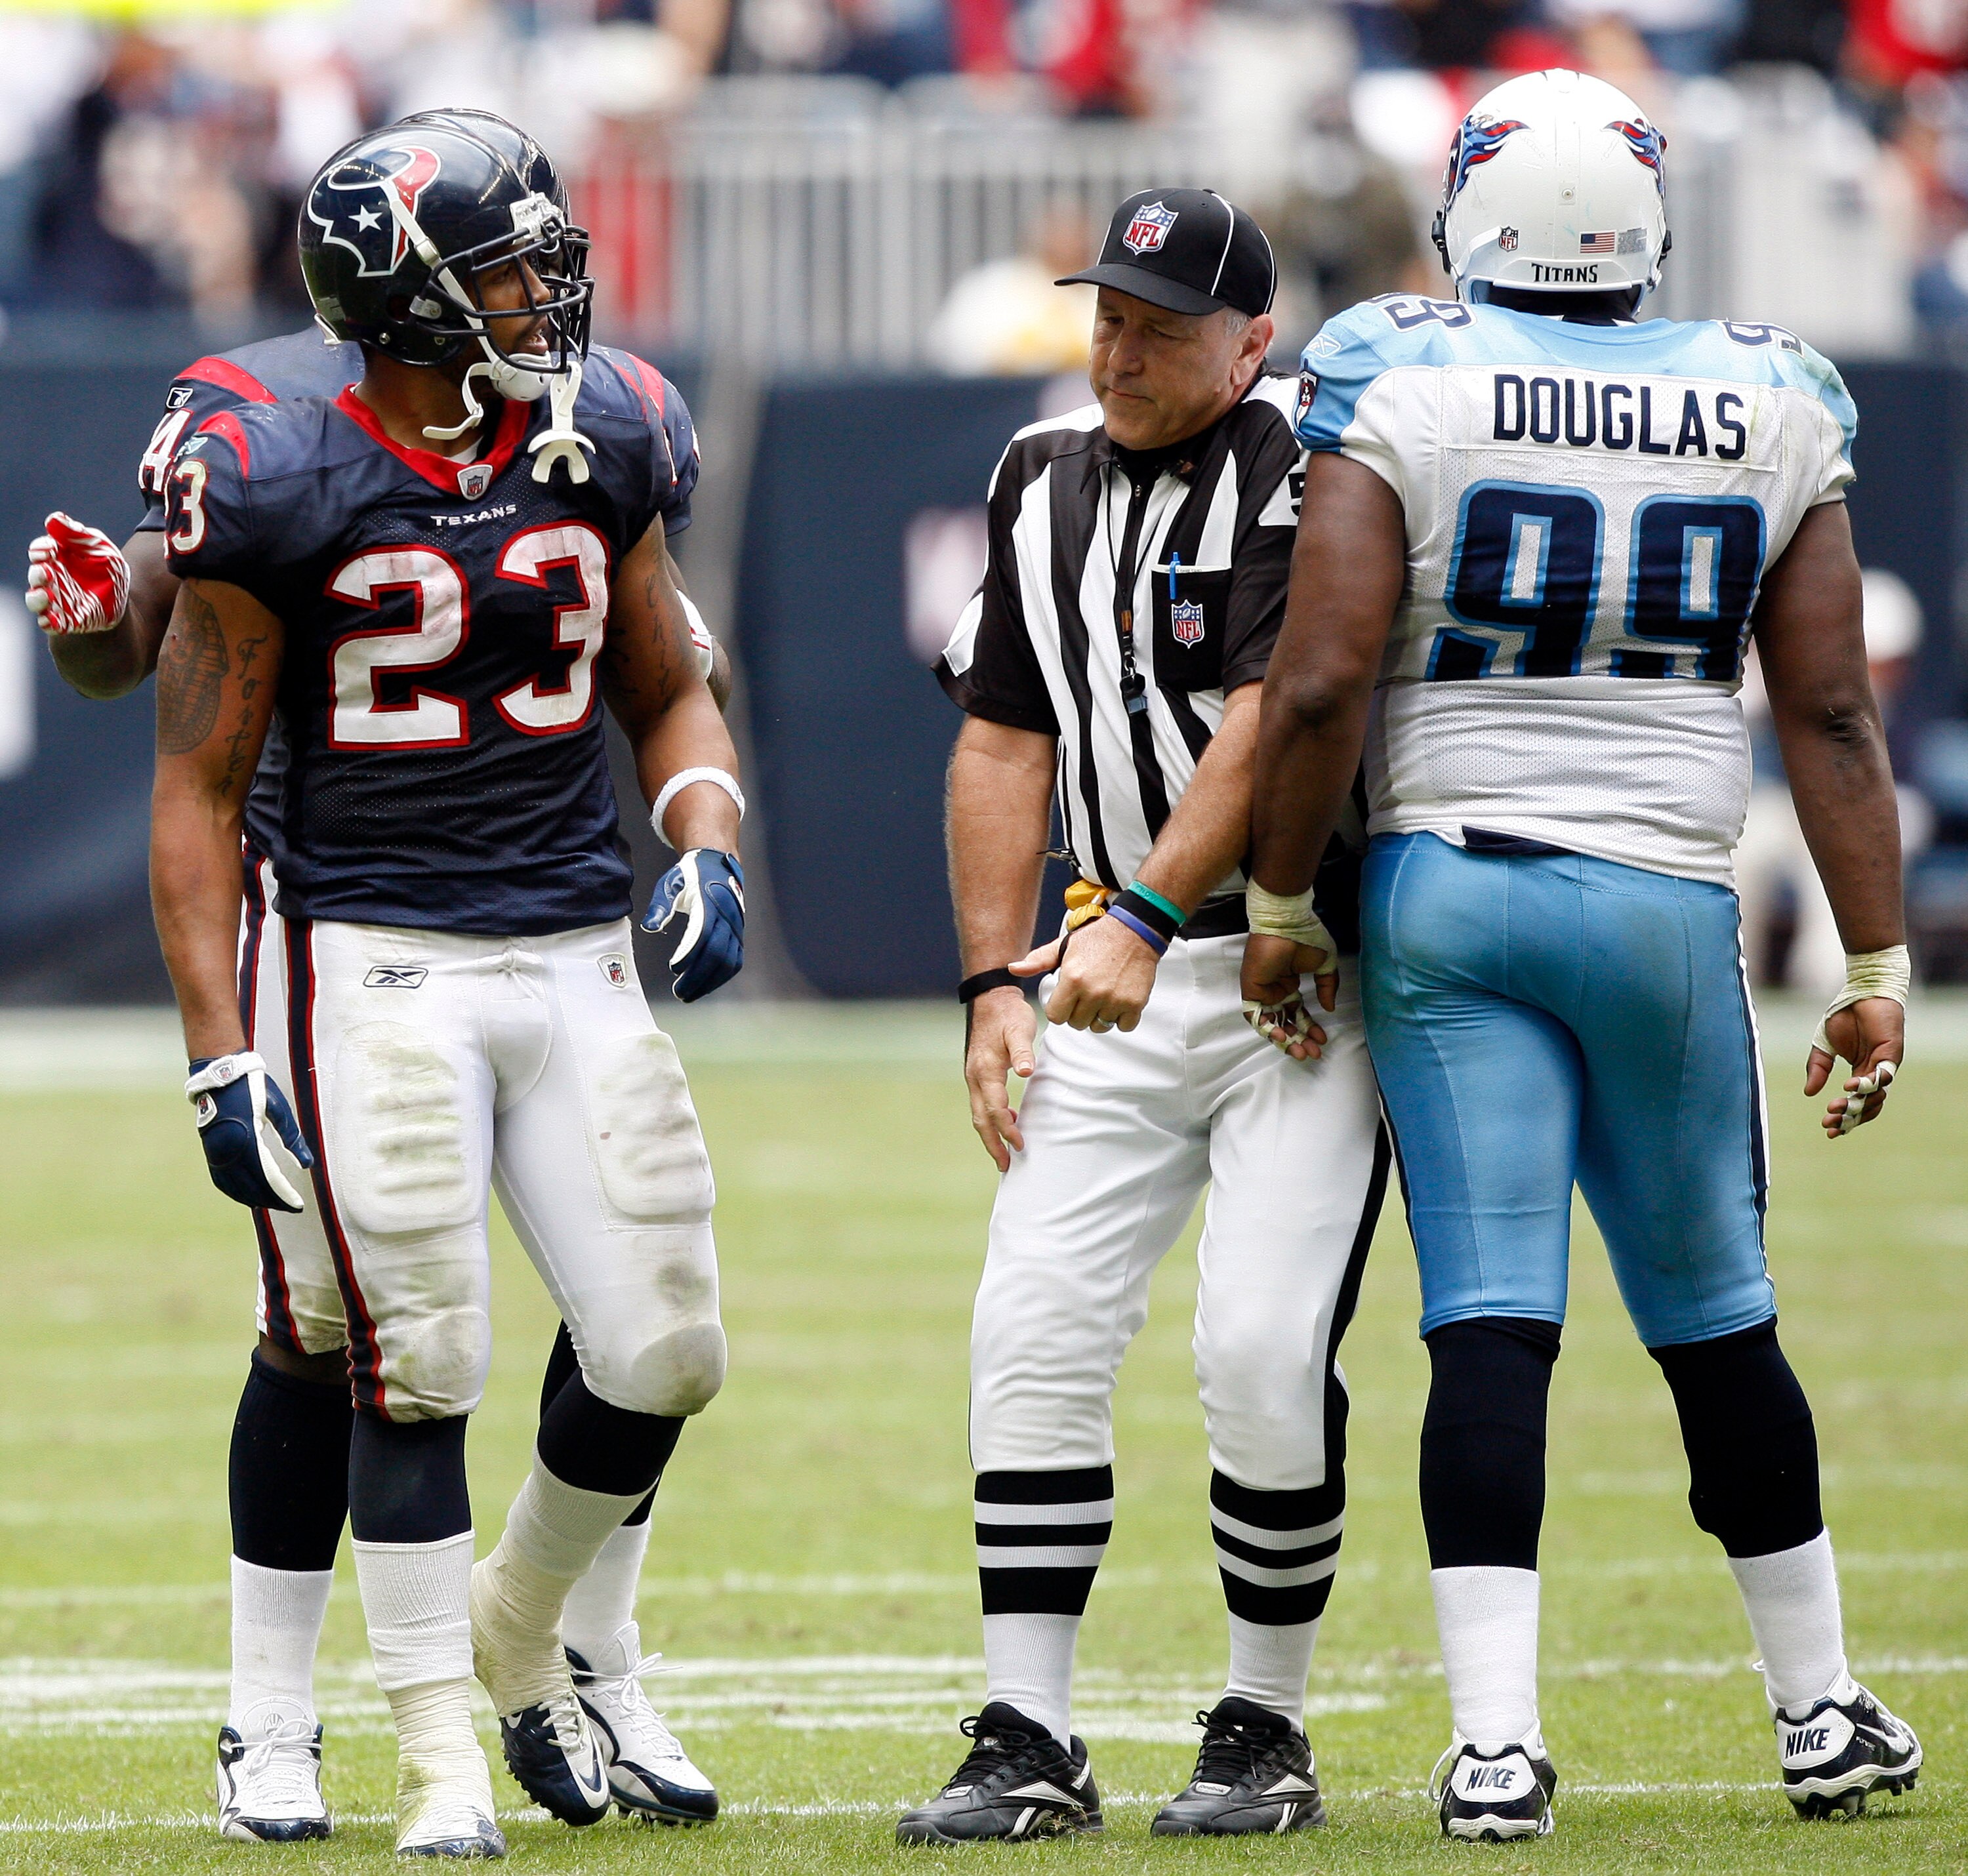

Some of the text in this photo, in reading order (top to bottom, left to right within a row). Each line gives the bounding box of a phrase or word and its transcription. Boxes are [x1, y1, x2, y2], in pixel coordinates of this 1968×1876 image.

[1125, 221, 1160, 247] NFL
[1500, 235, 1517, 249] NFL
[1531, 262, 1598, 283] TITANS
[1493, 374, 1746, 460] DOUGLAS
[136, 407, 194, 495] 4
[164, 458, 210, 559] 3
[430, 504, 517, 526] TEXANS
[1424, 478, 1767, 682] 99
[324, 519, 613, 751] 23
[1176, 620, 1200, 640] NFL
[1785, 1728, 1830, 1759] NIKE
[1464, 1766, 1517, 1792] NIKE
